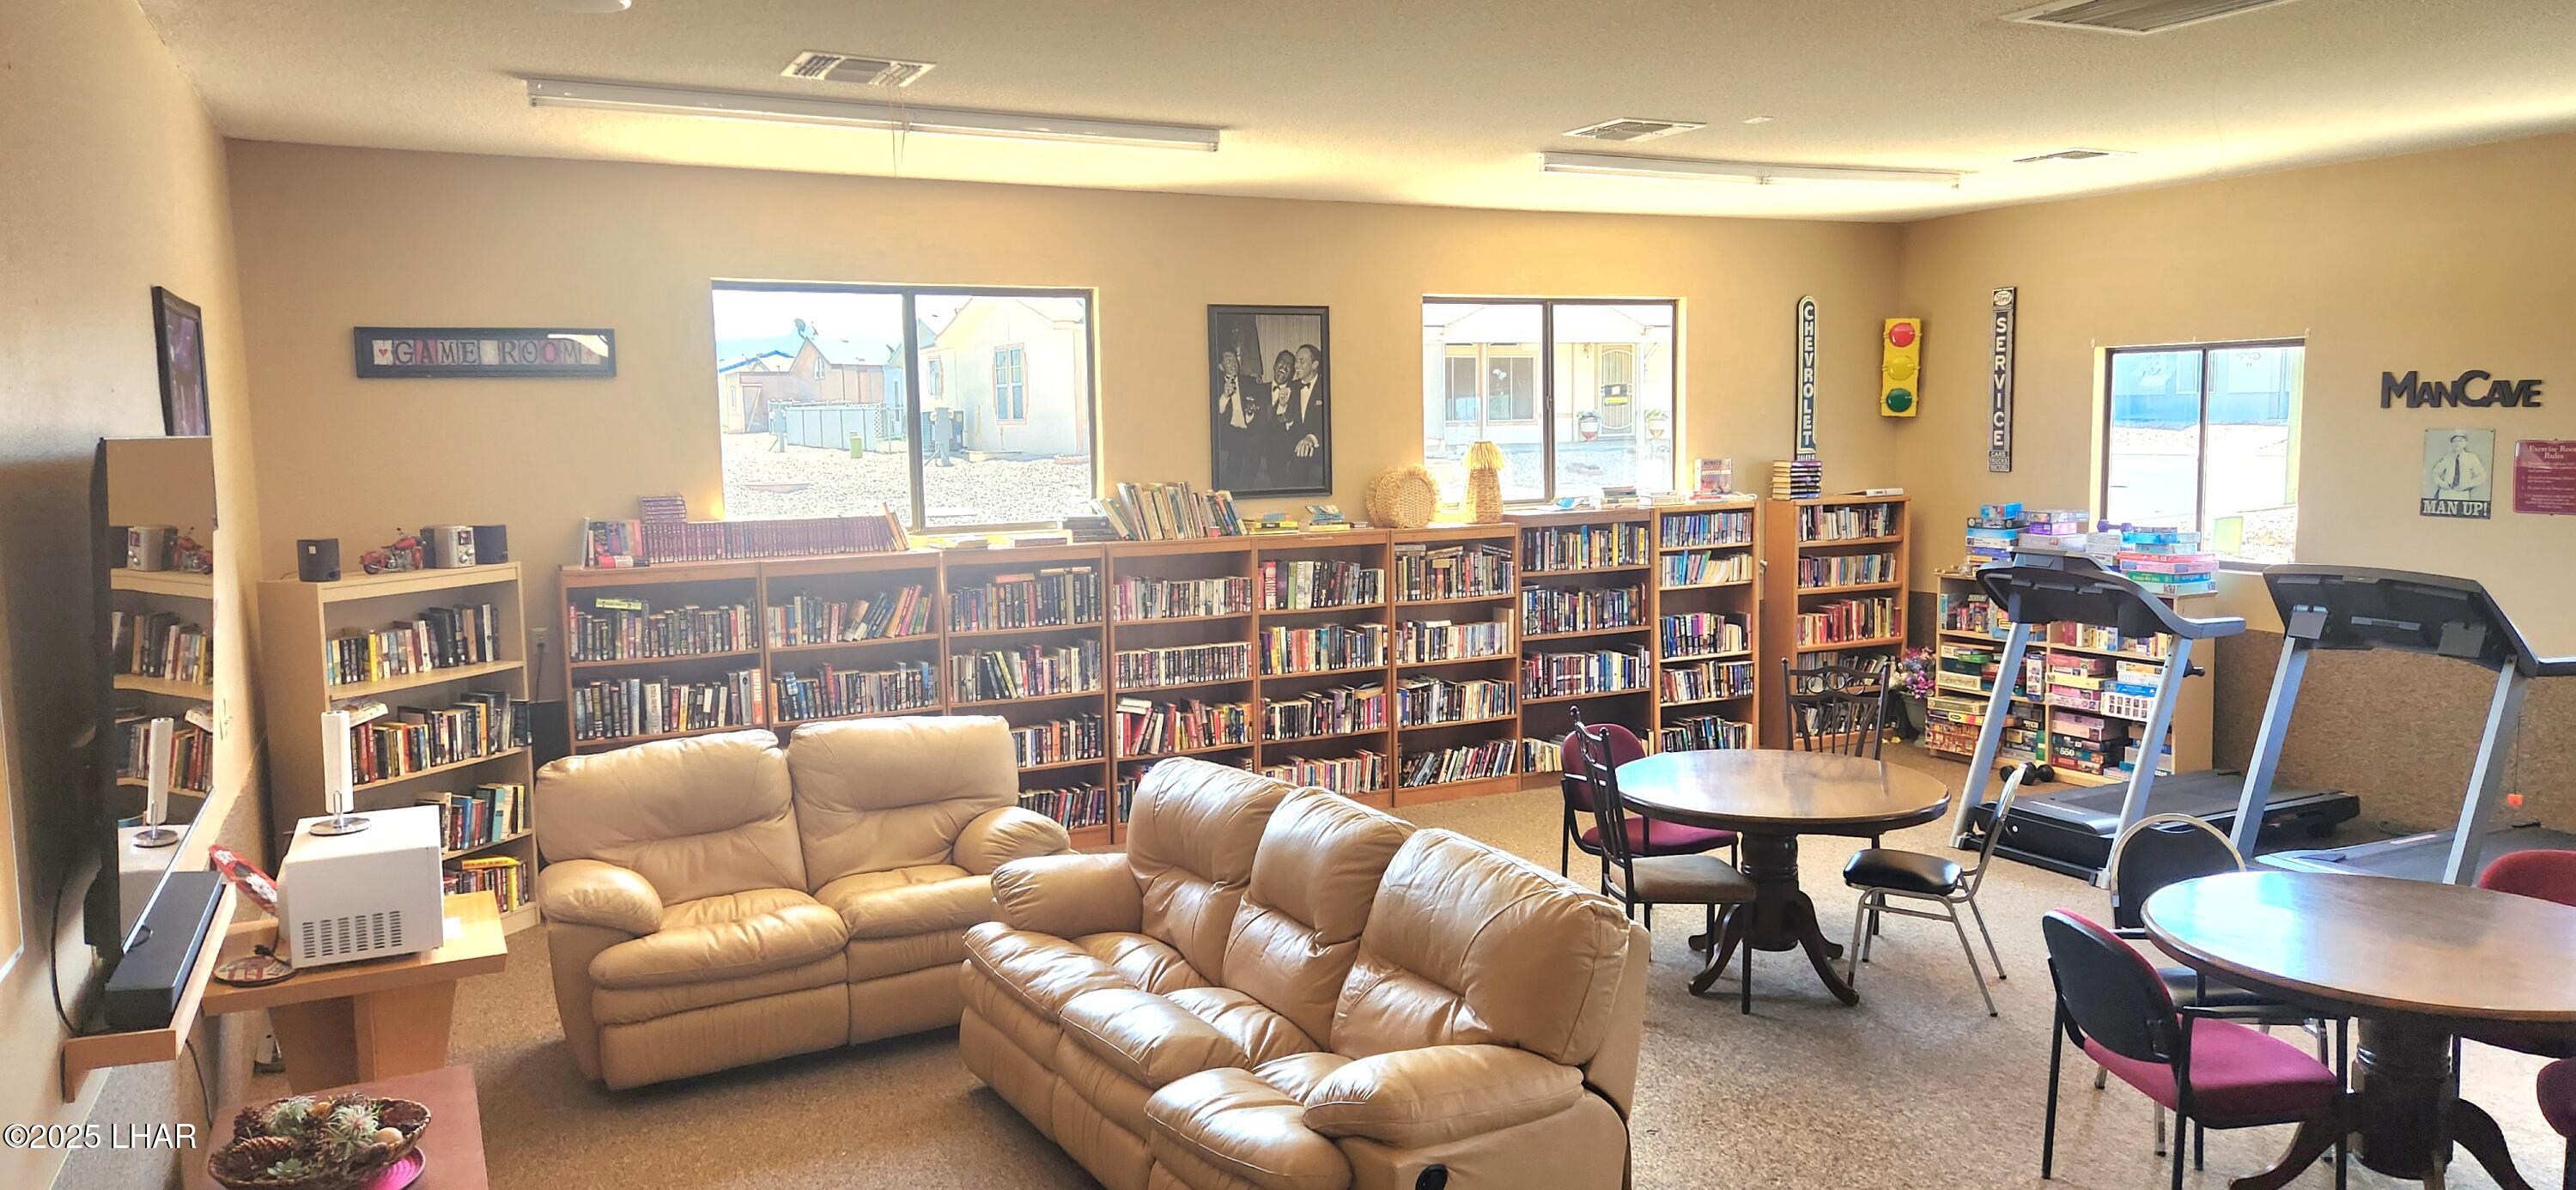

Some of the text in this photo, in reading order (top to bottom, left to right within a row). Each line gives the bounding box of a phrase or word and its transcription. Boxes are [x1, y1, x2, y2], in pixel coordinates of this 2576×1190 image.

[395, 340, 579, 364] GAME ROOM
[1801, 304, 1814, 446] CHEVROLET
[1993, 317, 2008, 446] SERVICE
[2422, 500, 2488, 517] MAN UP!
[2059, 747, 2075, 756] 550
